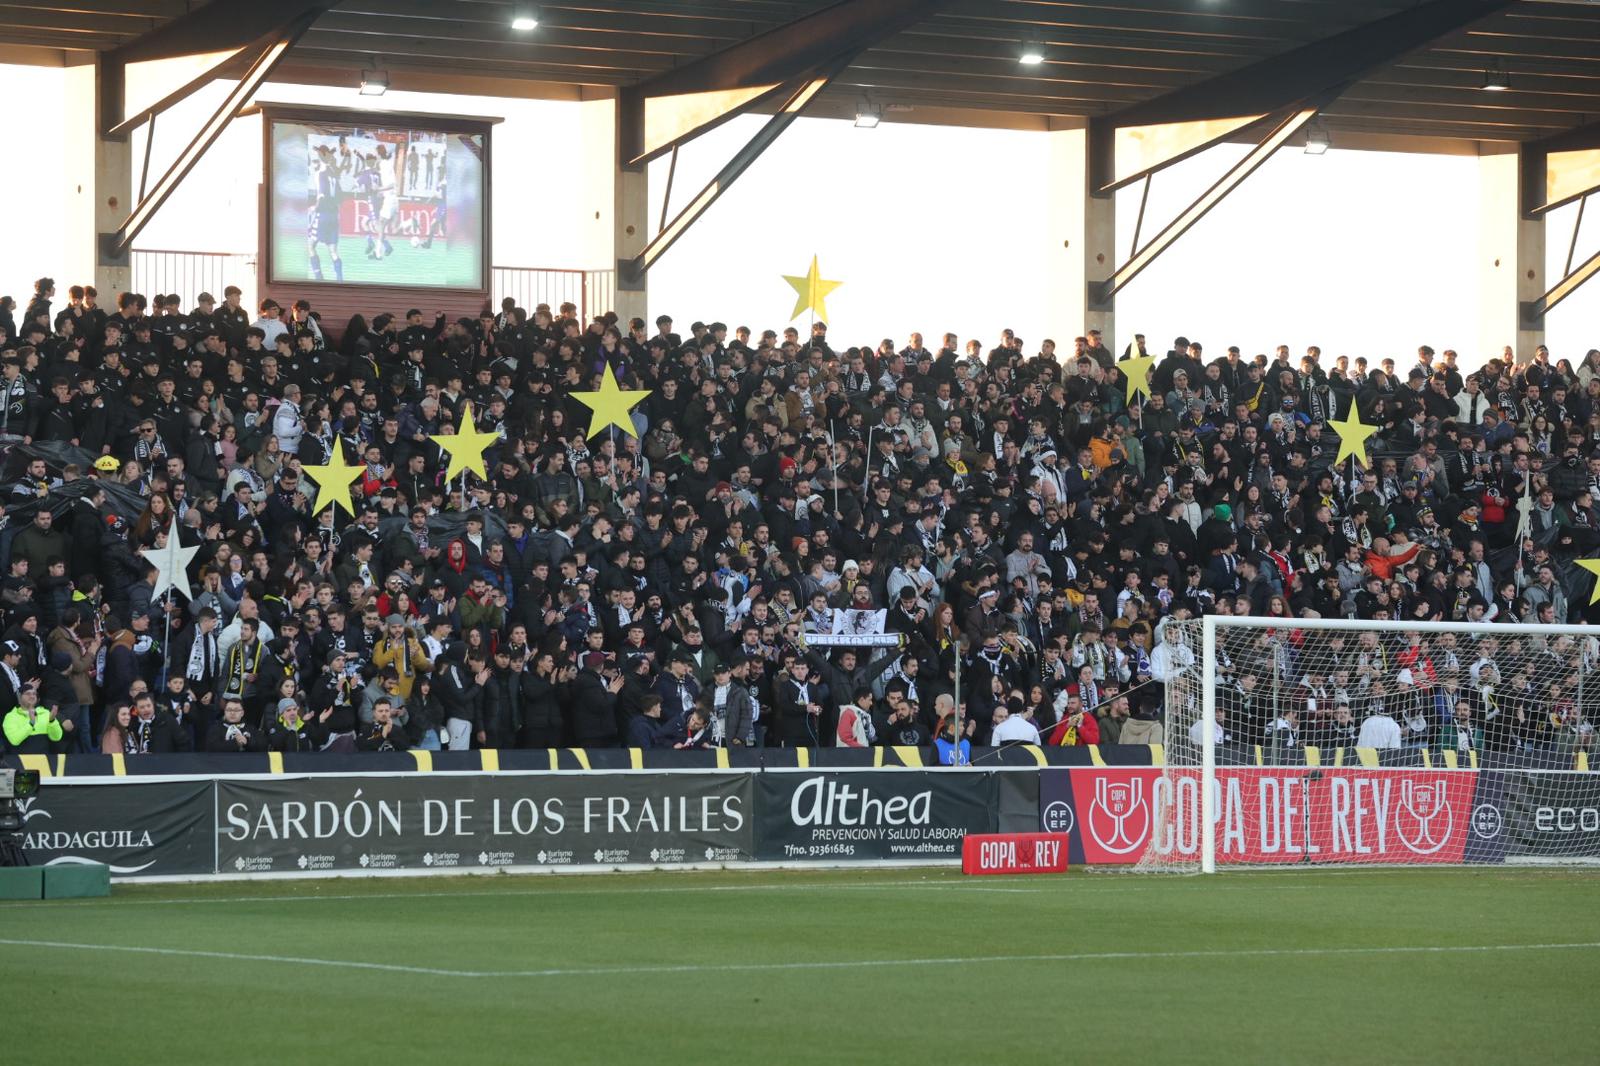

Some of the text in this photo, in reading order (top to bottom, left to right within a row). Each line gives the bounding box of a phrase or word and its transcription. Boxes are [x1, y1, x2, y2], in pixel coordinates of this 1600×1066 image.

[227, 788, 744, 841] SARDÓN DE LOS FRAILES
[1259, 777, 1320, 853] DEL
[1331, 777, 1391, 853] REY
[812, 828, 877, 840] PREVENCION
[879, 828, 885, 840] Y
[809, 843, 855, 856] 923616845
[890, 842, 955, 853] www.althea.es
[980, 840, 1060, 869] COPA REY
